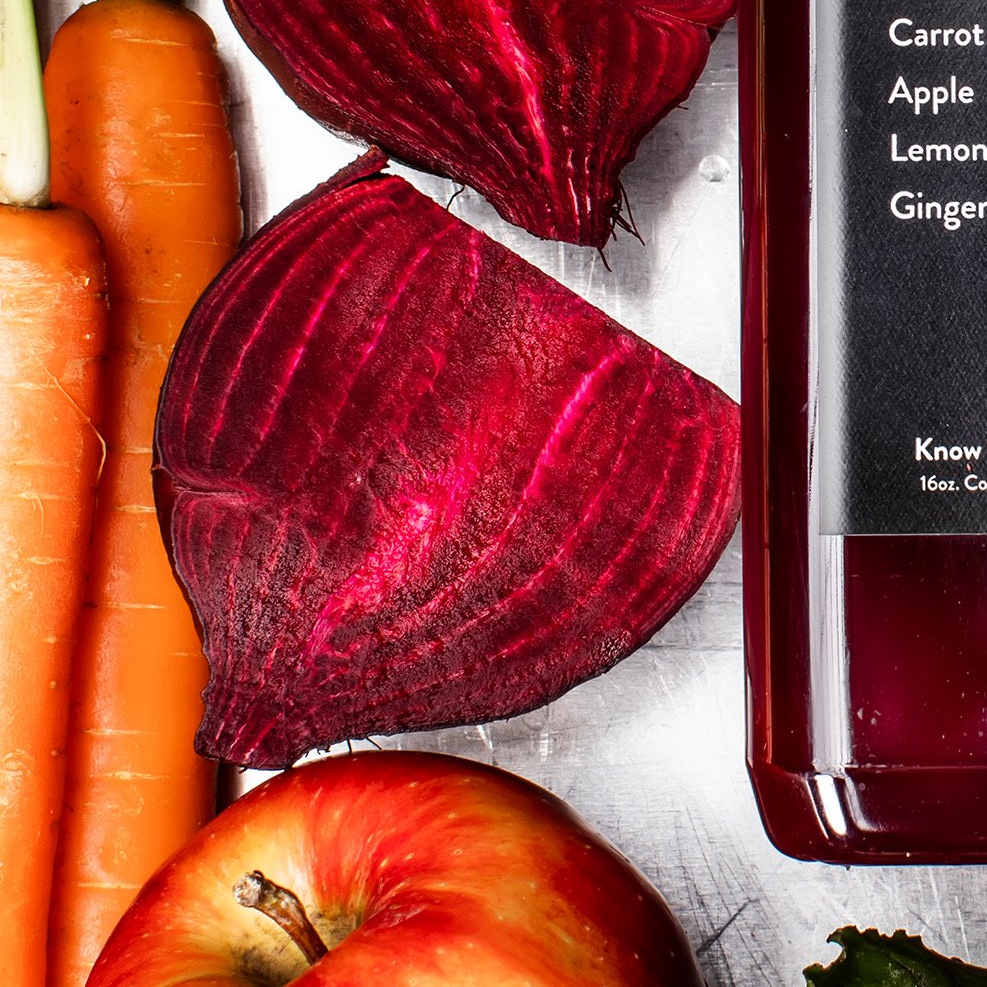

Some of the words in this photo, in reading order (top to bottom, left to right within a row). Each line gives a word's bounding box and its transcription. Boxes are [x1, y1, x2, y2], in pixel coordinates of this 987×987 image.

[888, 18, 985, 47] Carrot
[888, 76, 975, 115] Apple
[915, 437, 982, 461] Know
[919, 474, 961, 492] 16oz.
